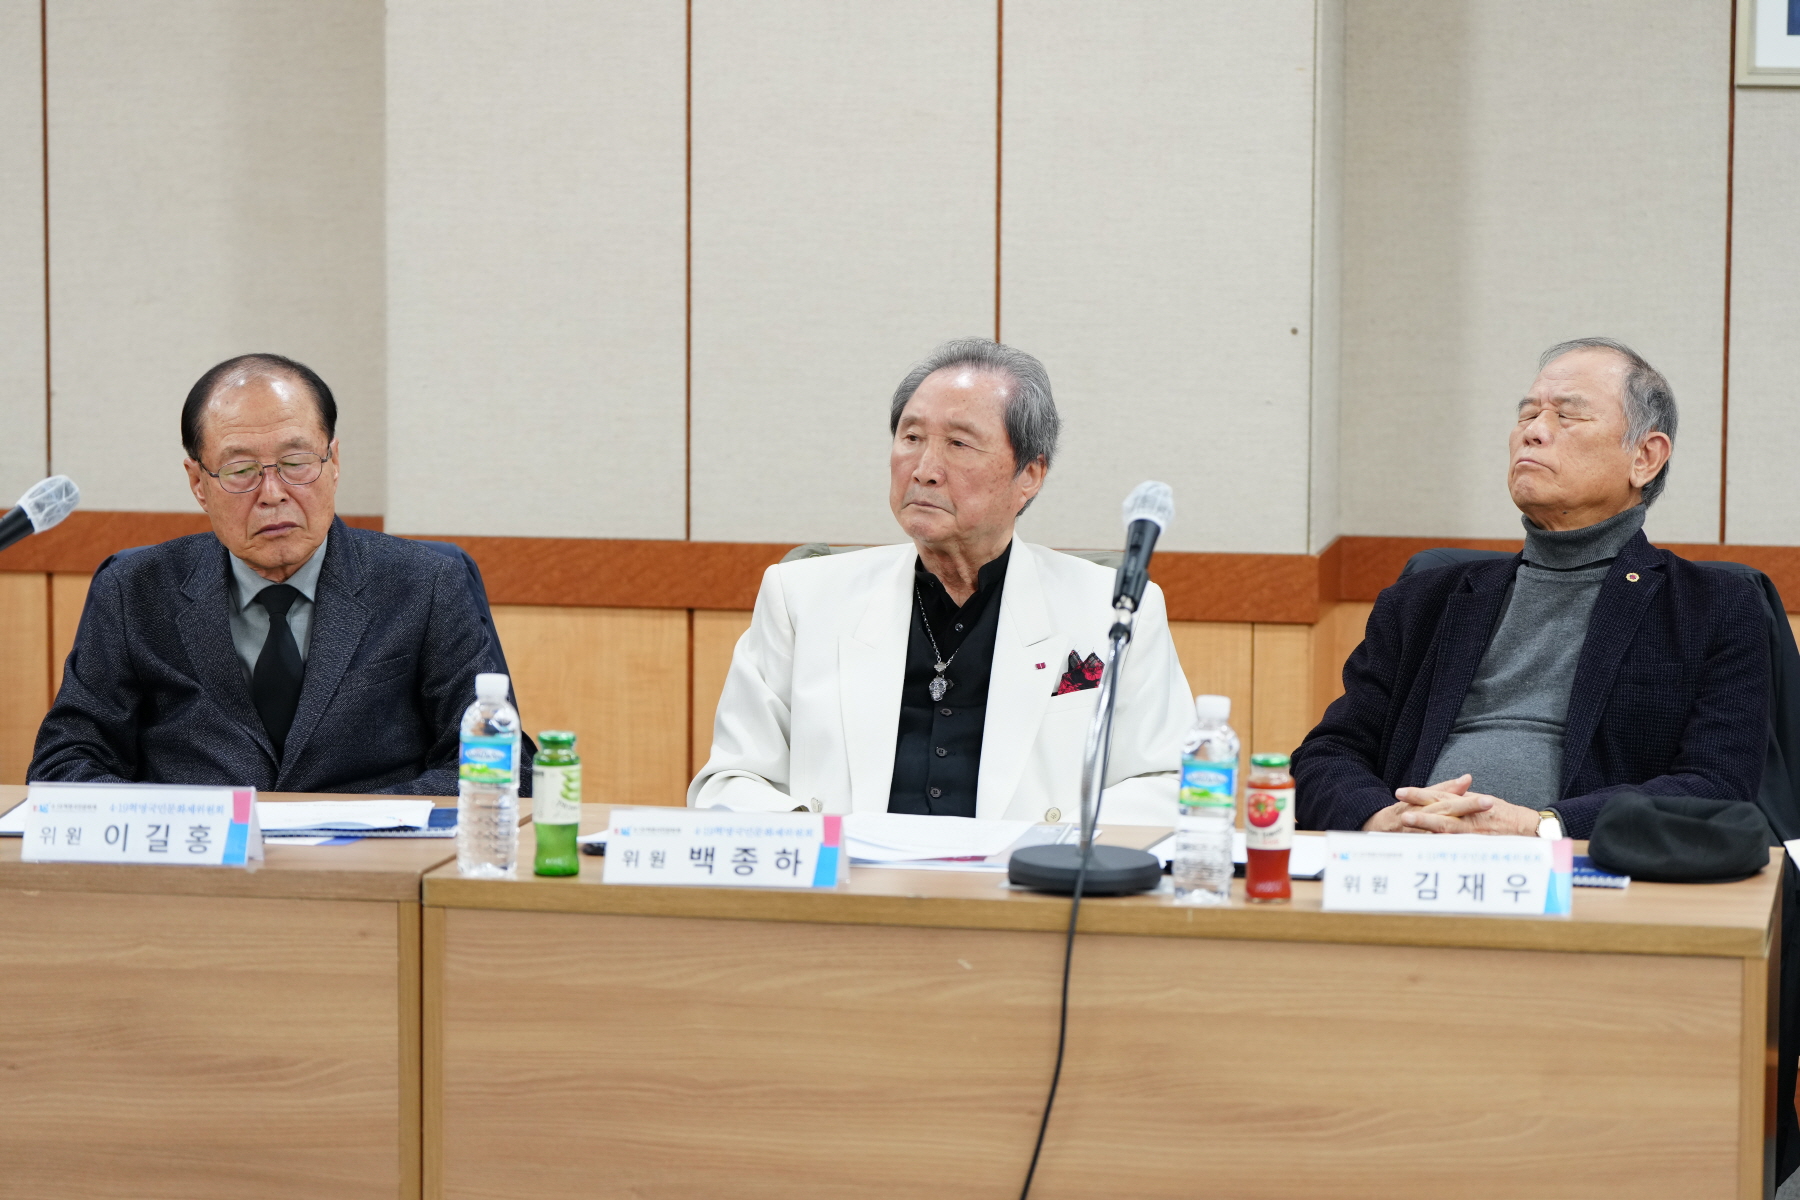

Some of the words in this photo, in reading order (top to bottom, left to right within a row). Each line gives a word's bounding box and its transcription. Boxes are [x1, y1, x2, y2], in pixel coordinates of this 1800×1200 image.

[39, 826, 82, 846] 위원
[104, 823, 212, 854] 이길홍
[622, 849, 667, 869] 위원
[689, 846, 803, 877] 백종하
[1343, 874, 1388, 894] 위원
[1413, 871, 1531, 903] 김재우
